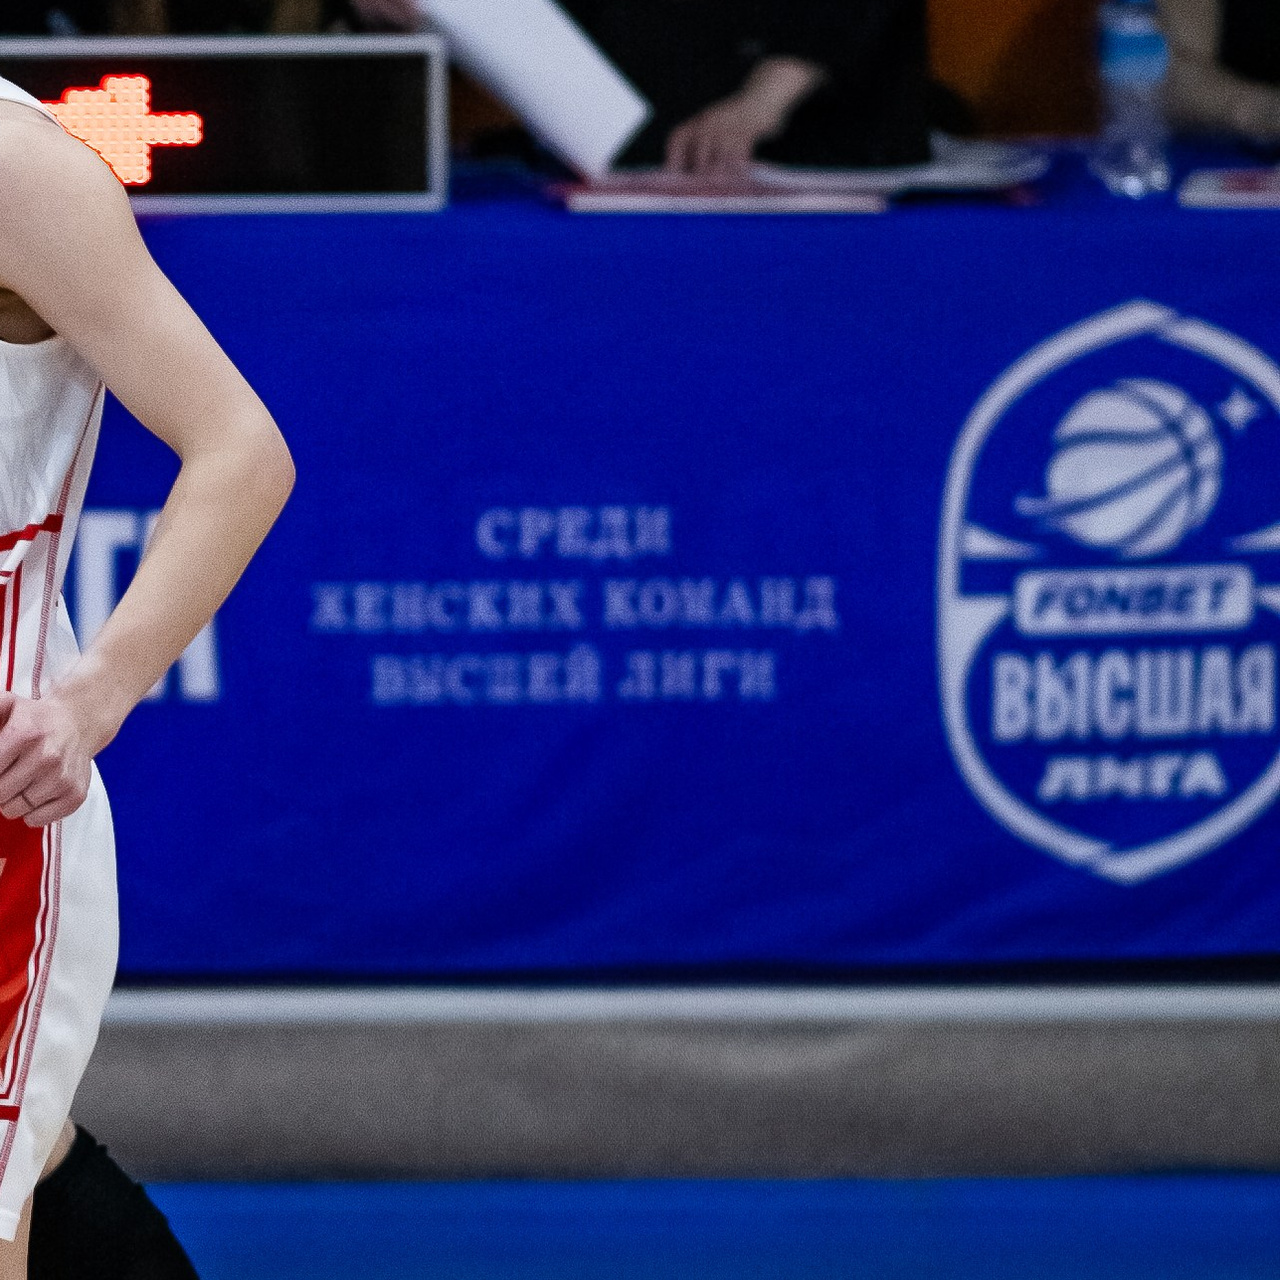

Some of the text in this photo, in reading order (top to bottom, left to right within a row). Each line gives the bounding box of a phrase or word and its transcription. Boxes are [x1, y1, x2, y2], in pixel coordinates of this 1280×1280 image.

[475, 506, 671, 561] СРЕДИ
[603, 577, 838, 634] КОМАНД
[1029, 579, 1235, 618] FONBET
[618, 649, 776, 702] ЛИГИ
[991, 644, 1276, 742] ВЫСШАЯ
[1036, 751, 1228, 801] ЛИГА
